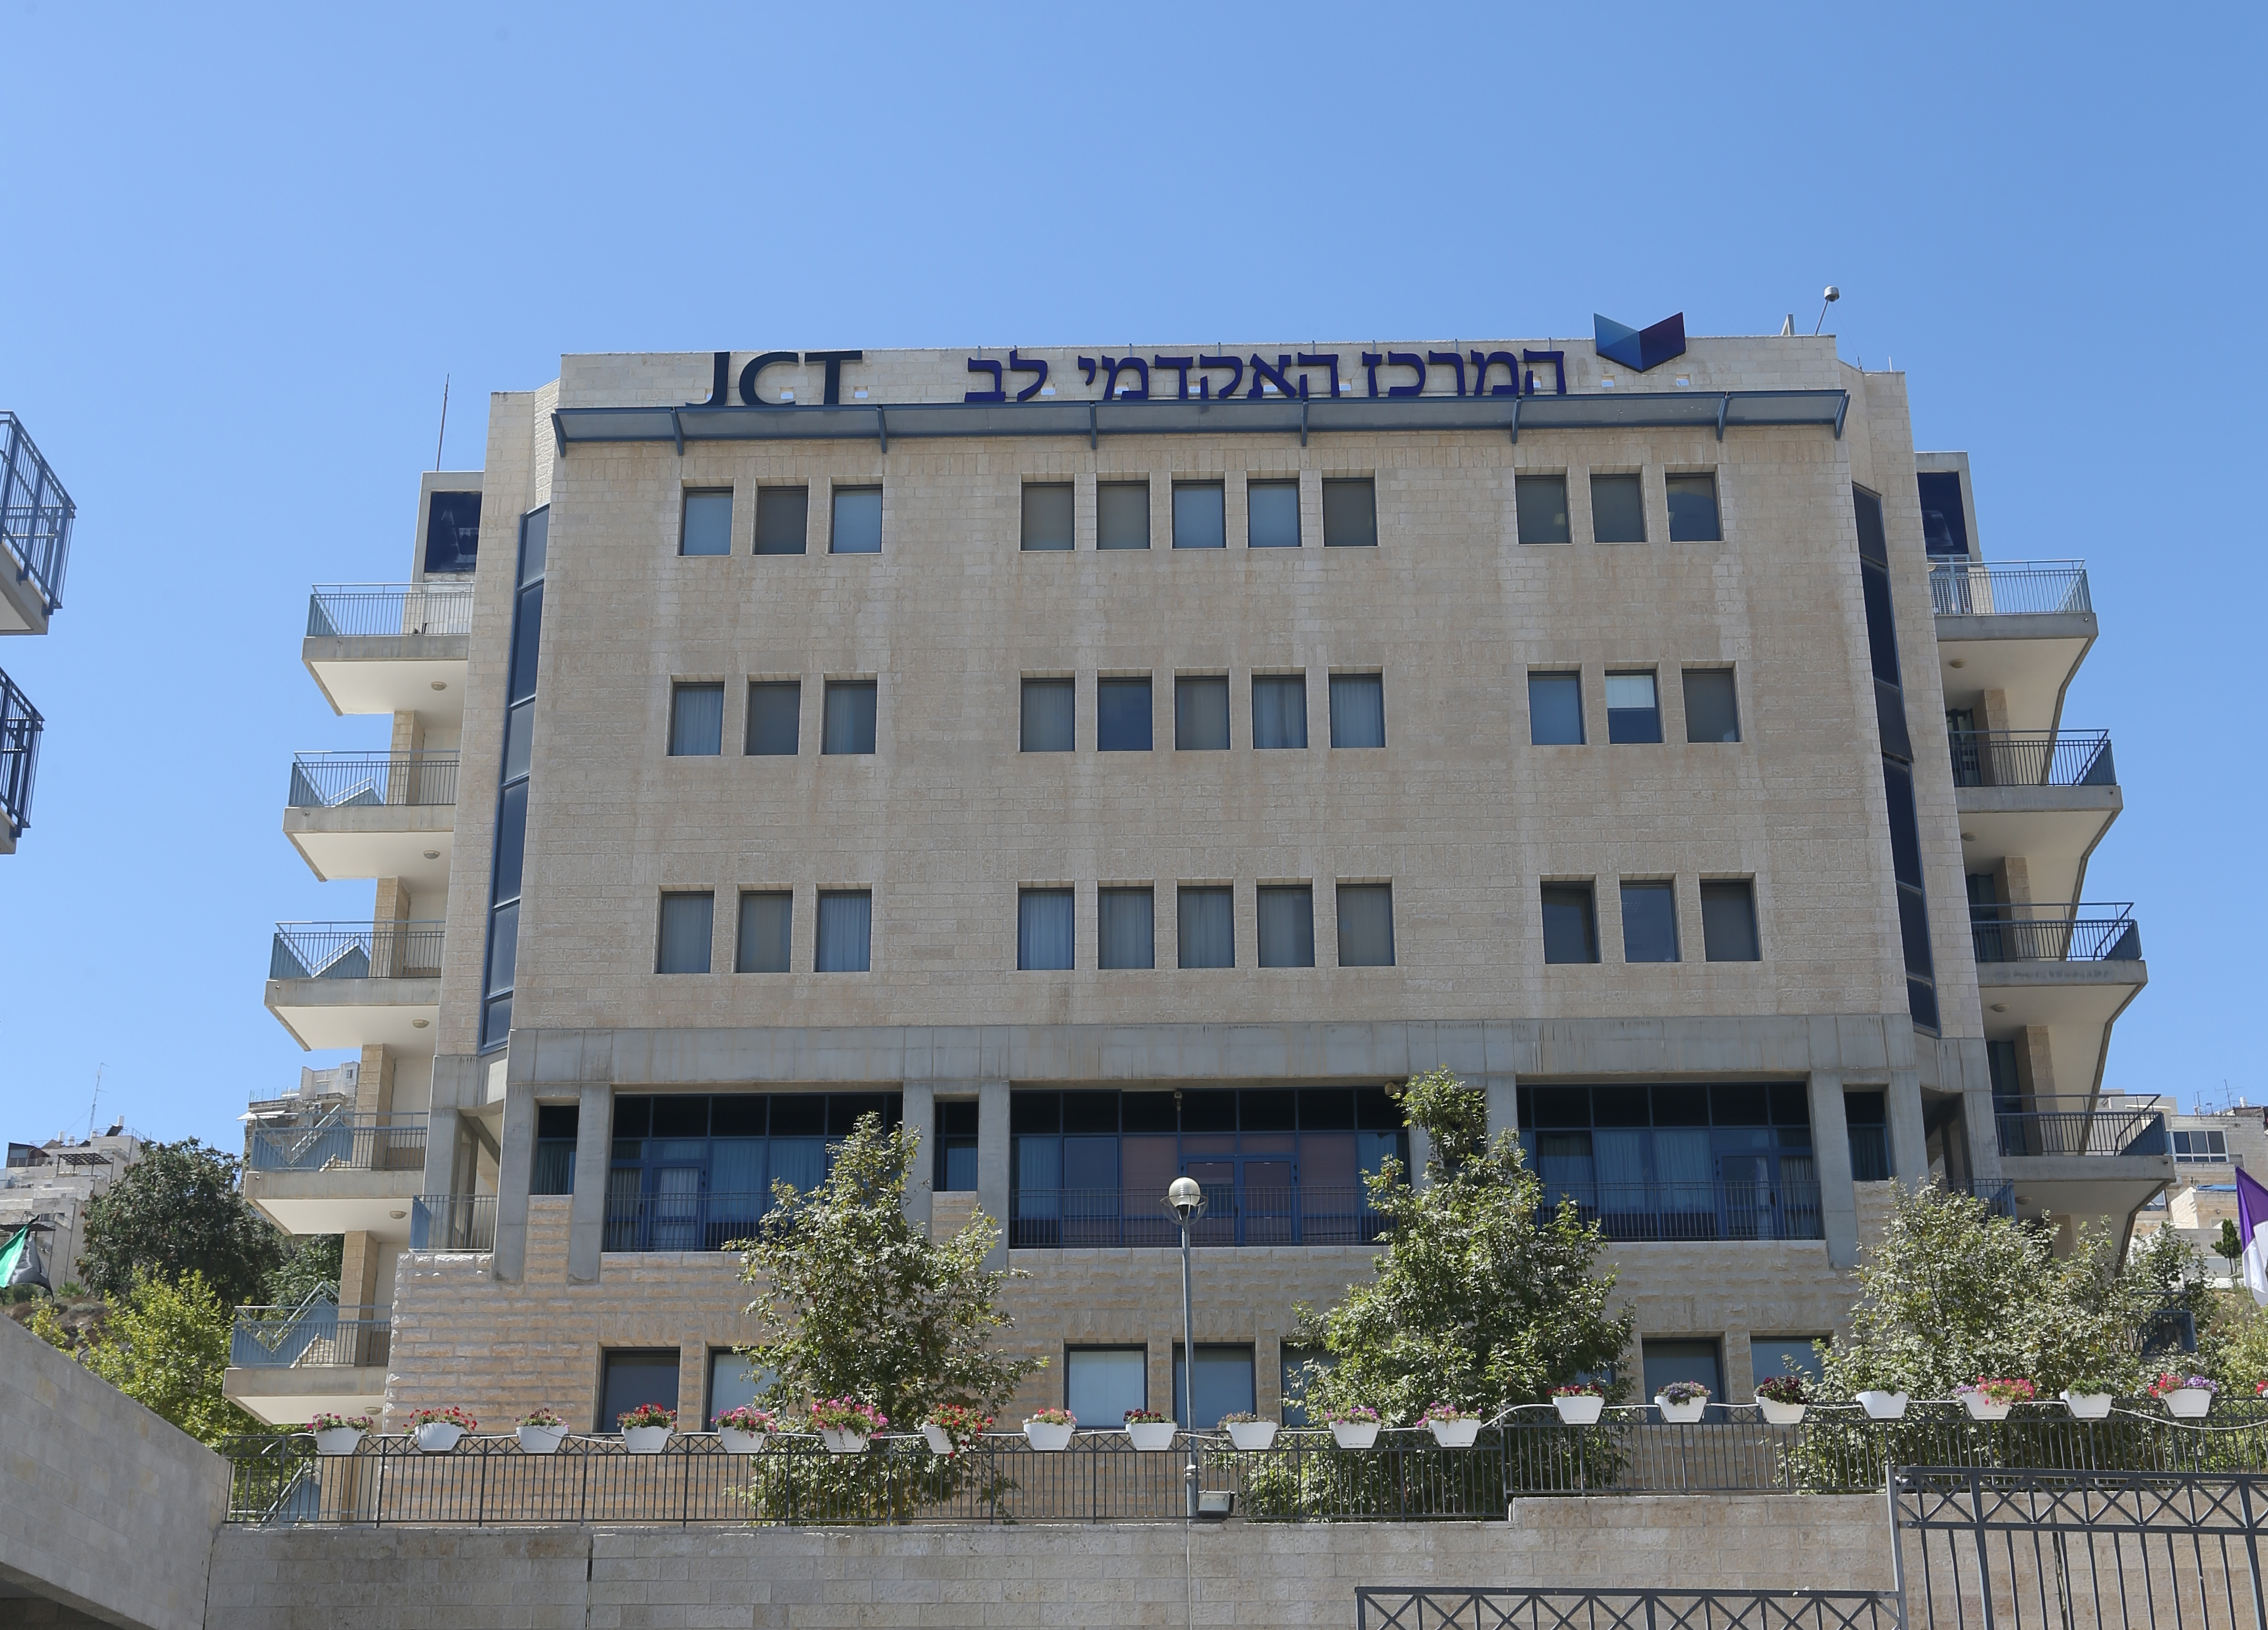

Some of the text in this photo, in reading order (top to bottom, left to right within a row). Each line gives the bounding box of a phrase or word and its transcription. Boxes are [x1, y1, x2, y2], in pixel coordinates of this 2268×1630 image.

[684, 350, 862, 406] JCT
[964, 348, 1566, 402] המרכז האקדמי לב
